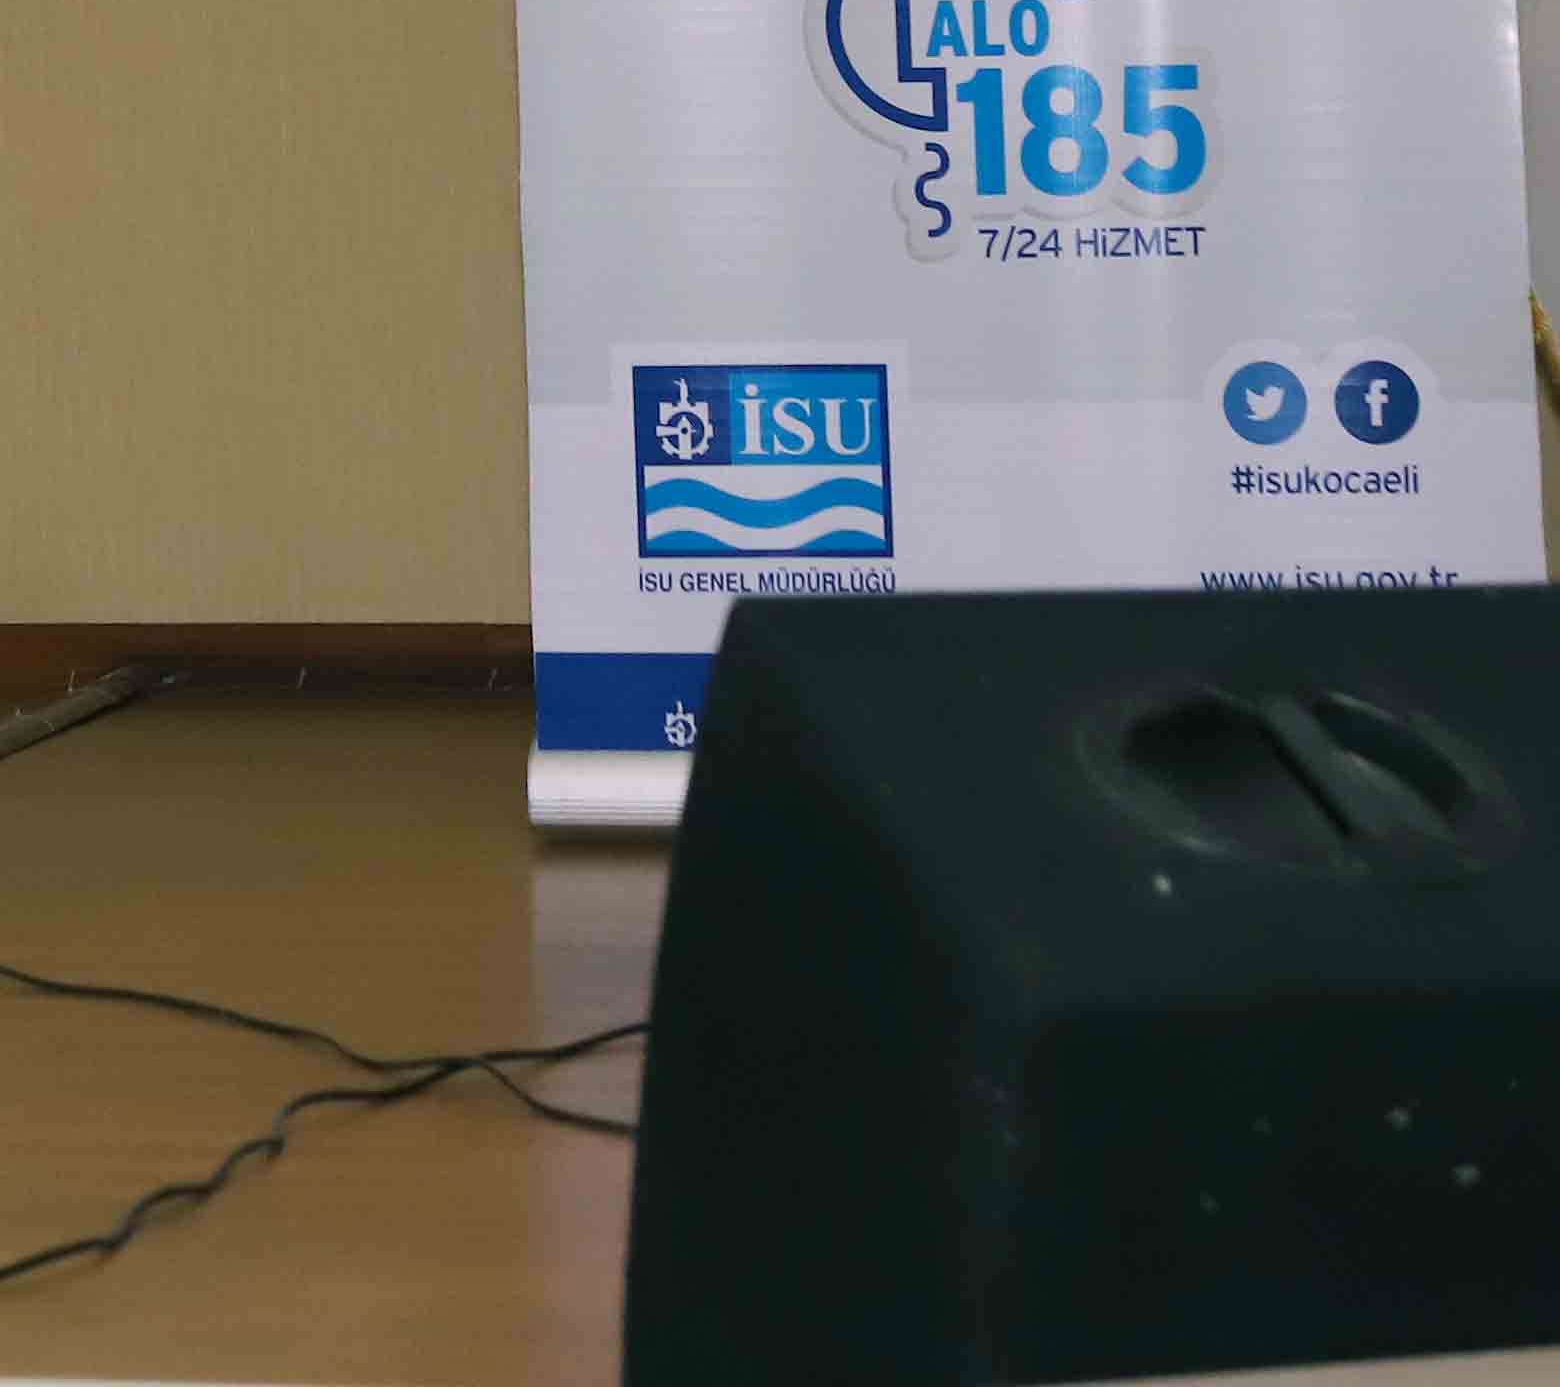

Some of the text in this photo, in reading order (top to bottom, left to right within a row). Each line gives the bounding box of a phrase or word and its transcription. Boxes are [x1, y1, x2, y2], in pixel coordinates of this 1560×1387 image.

[956, 64, 1208, 197] 185
[979, 226, 1063, 262] 7/24
[737, 383, 878, 457] İSU
[1231, 465, 1420, 494] #isukocaeli
[639, 566, 896, 593] İSU GENEL MÜDÜRLÜĞÜ
